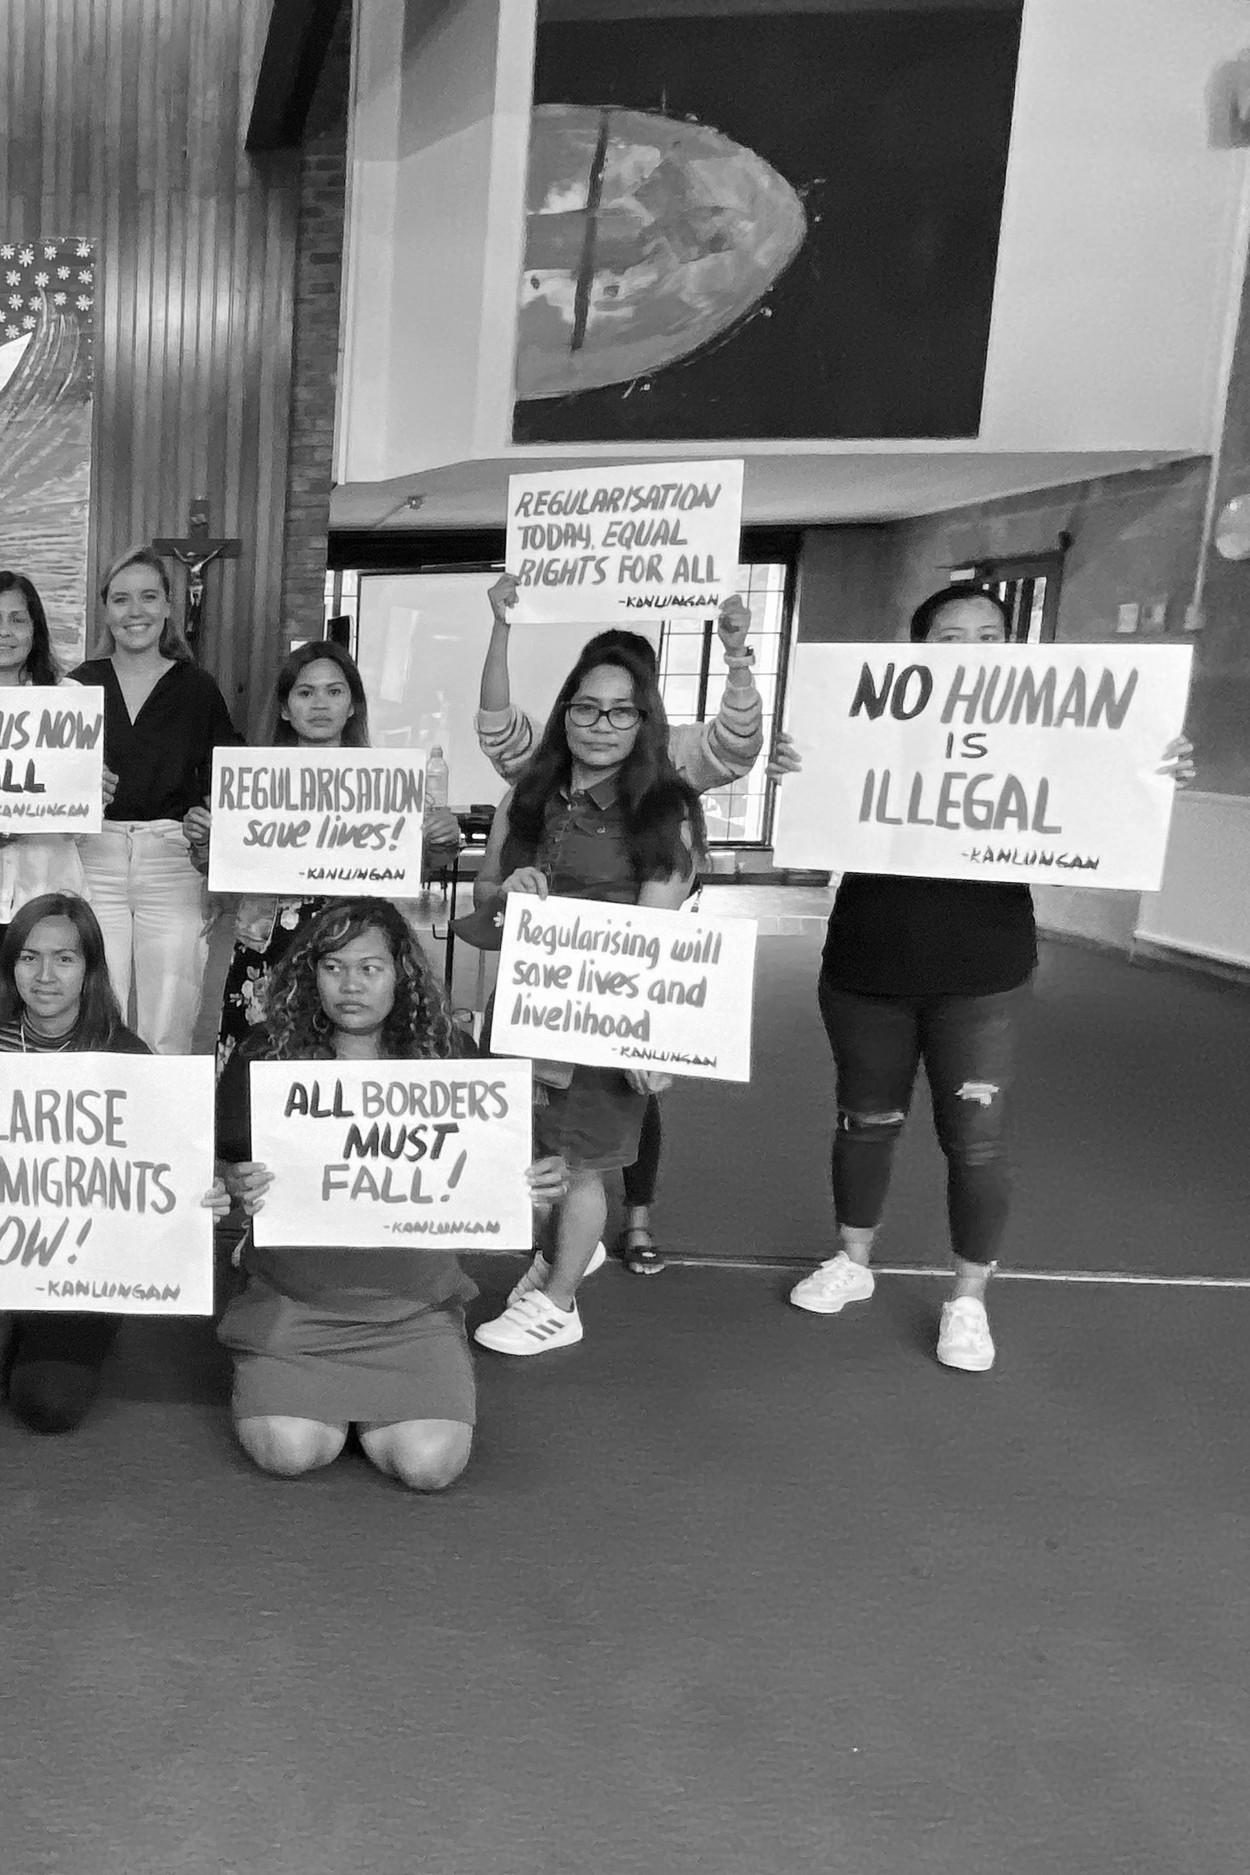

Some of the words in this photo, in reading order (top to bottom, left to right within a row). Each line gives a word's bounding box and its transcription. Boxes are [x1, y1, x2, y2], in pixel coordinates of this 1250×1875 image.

[515, 483, 721, 517] REGULARISATION
[602, 518, 688, 551] EQUAL
[519, 555, 610, 586] RIGHTS
[618, 554, 663, 584] FOR
[672, 554, 721, 584] ALL
[848, 661, 933, 721] NO
[940, 664, 1139, 730] HUMAN
[35, 709, 103, 750] NOW
[945, 732, 988, 759] IS
[218, 766, 424, 814] REGULARISATION
[858, 768, 1062, 834] ILLEGAL
[243, 819, 311, 848] save
[315, 815, 405, 851] lives!
[516, 908, 660, 970] Regularising
[670, 928, 722, 964] will
[512, 960, 572, 989] save
[577, 958, 640, 999] lives
[647, 975, 707, 1008] and
[510, 992, 650, 1042] livelihood
[284, 1078, 354, 1118] ALL
[362, 1080, 509, 1121] BORDERS
[343, 1121, 459, 1162] MUST
[321, 1149, 467, 1204] FALL!
